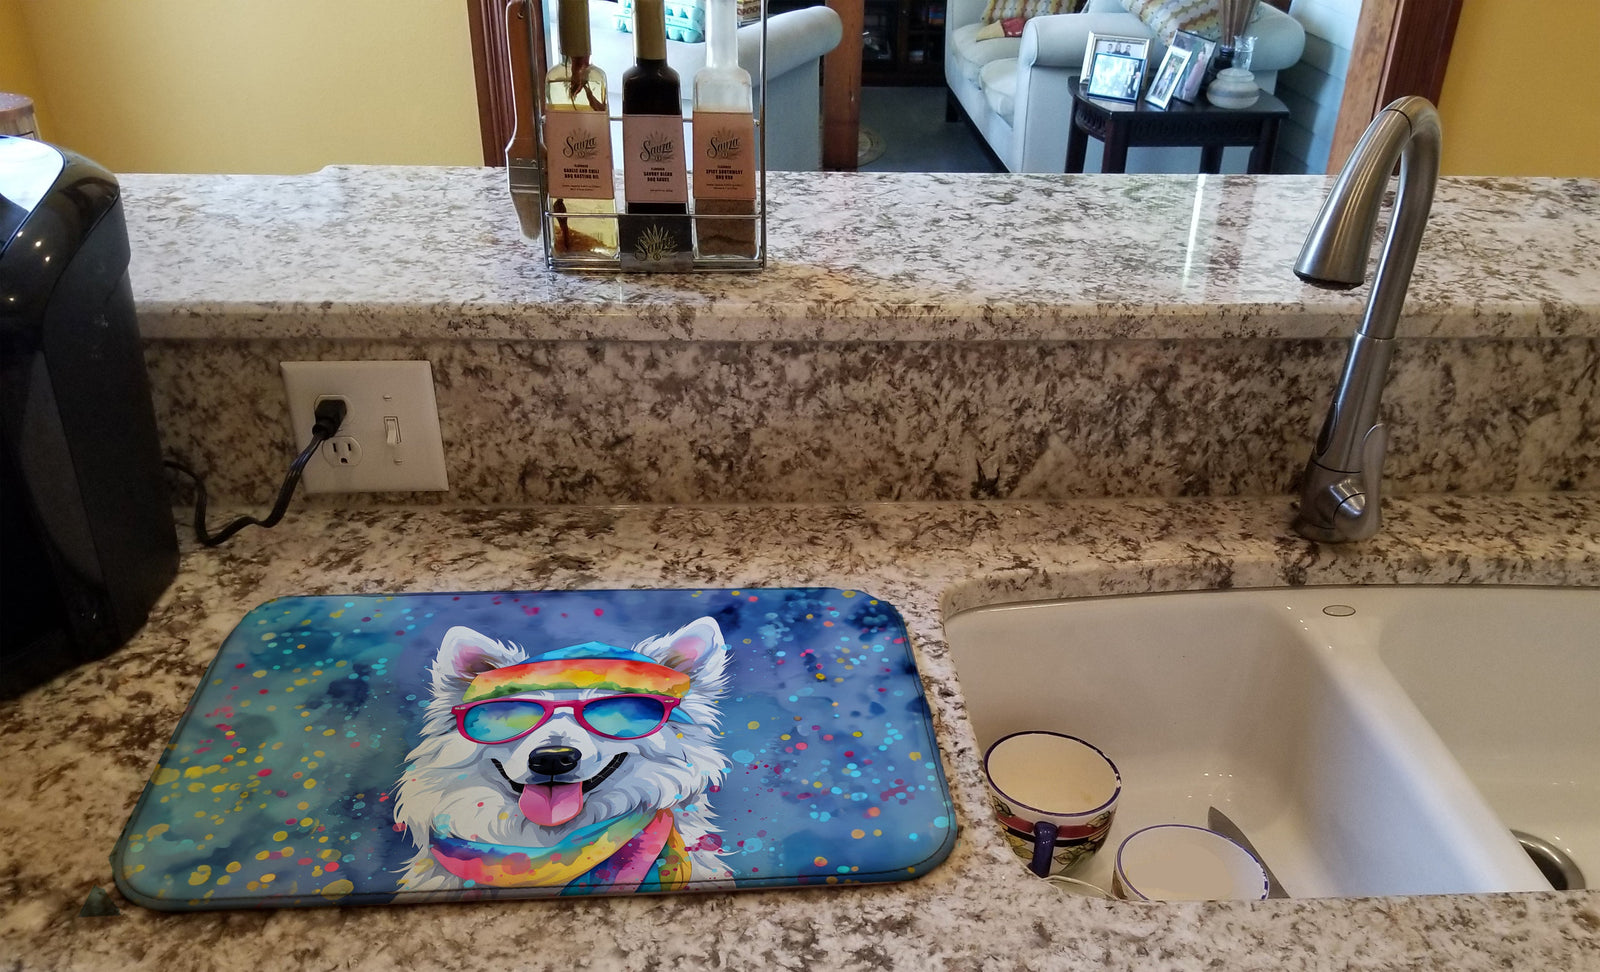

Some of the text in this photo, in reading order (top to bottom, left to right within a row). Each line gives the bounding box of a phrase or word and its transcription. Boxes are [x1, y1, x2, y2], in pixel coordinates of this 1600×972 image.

[563, 136, 597, 158] Sauza
[640, 140, 673, 161] Sauza
[707, 137, 740, 158] Sauza
